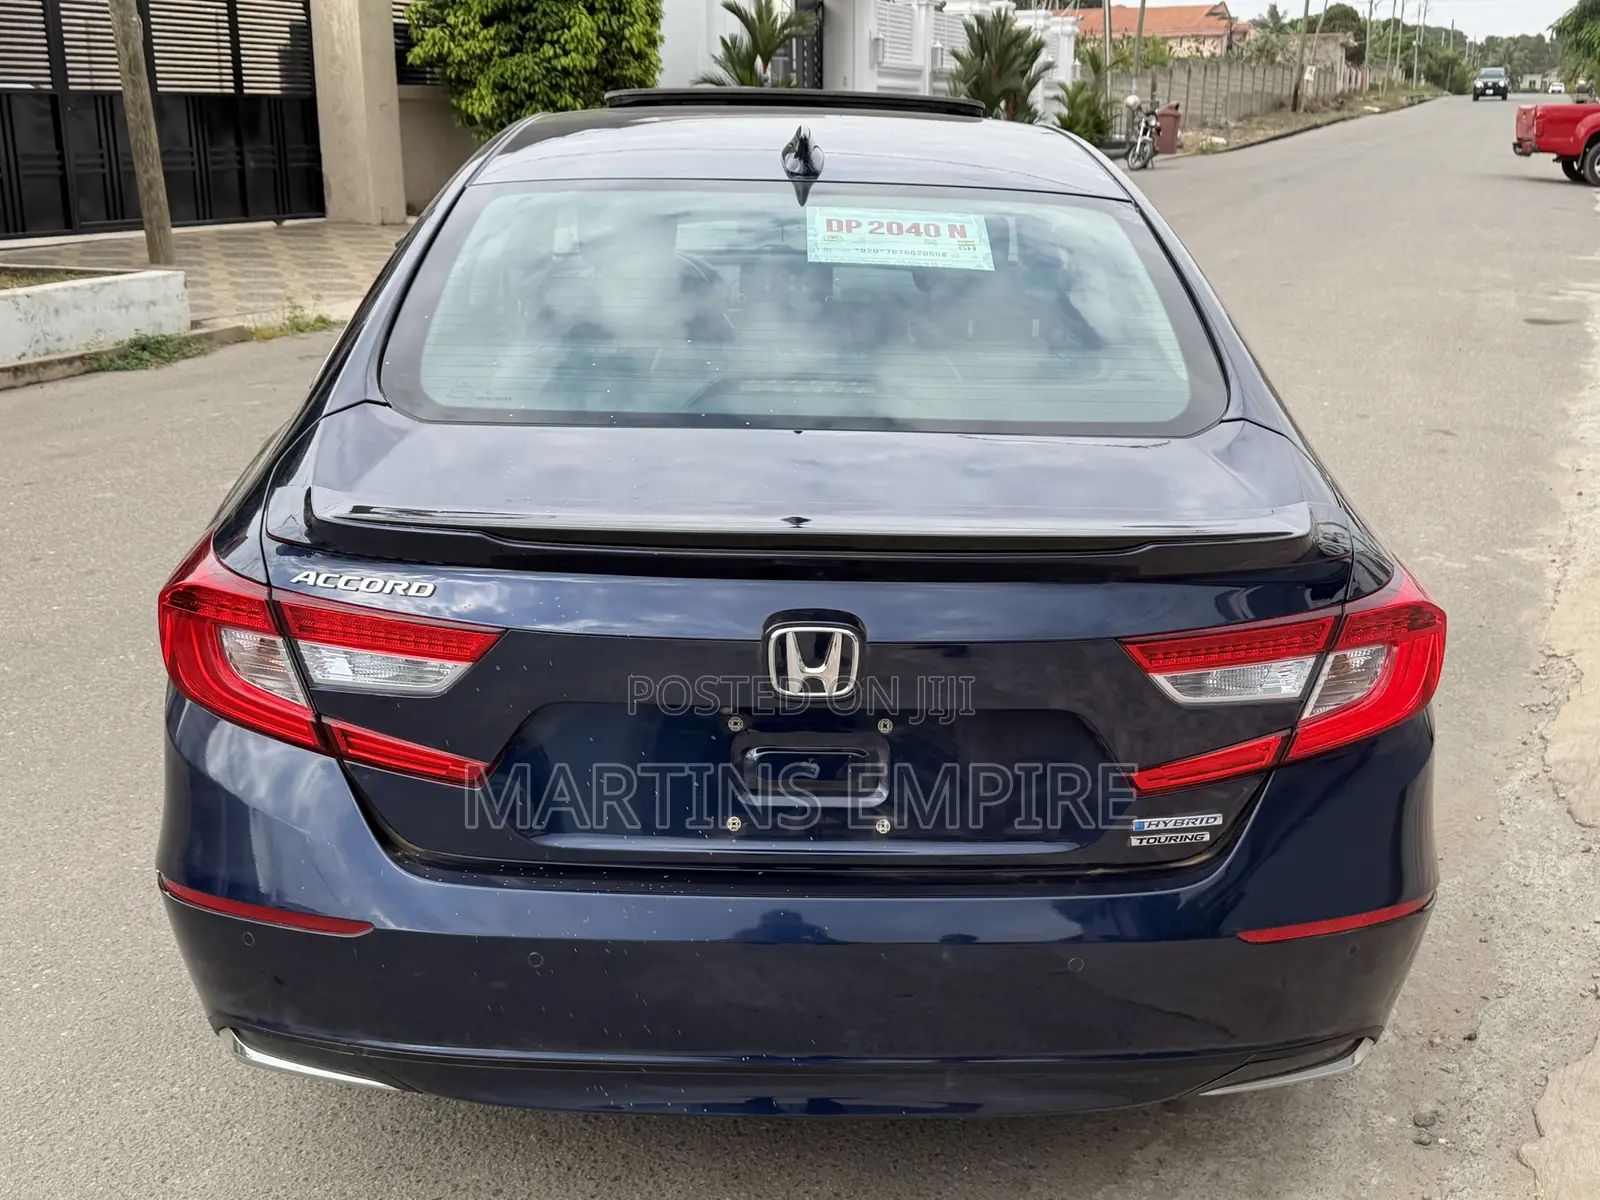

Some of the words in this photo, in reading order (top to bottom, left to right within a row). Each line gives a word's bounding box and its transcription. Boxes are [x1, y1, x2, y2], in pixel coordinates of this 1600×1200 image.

[825, 218, 862, 234] DP
[868, 220, 942, 238] 2040
[948, 224, 968, 239] N
[290, 570, 437, 598] ACCORD
[1147, 816, 1218, 828] HYBRID
[1136, 833, 1206, 845] TOURING
